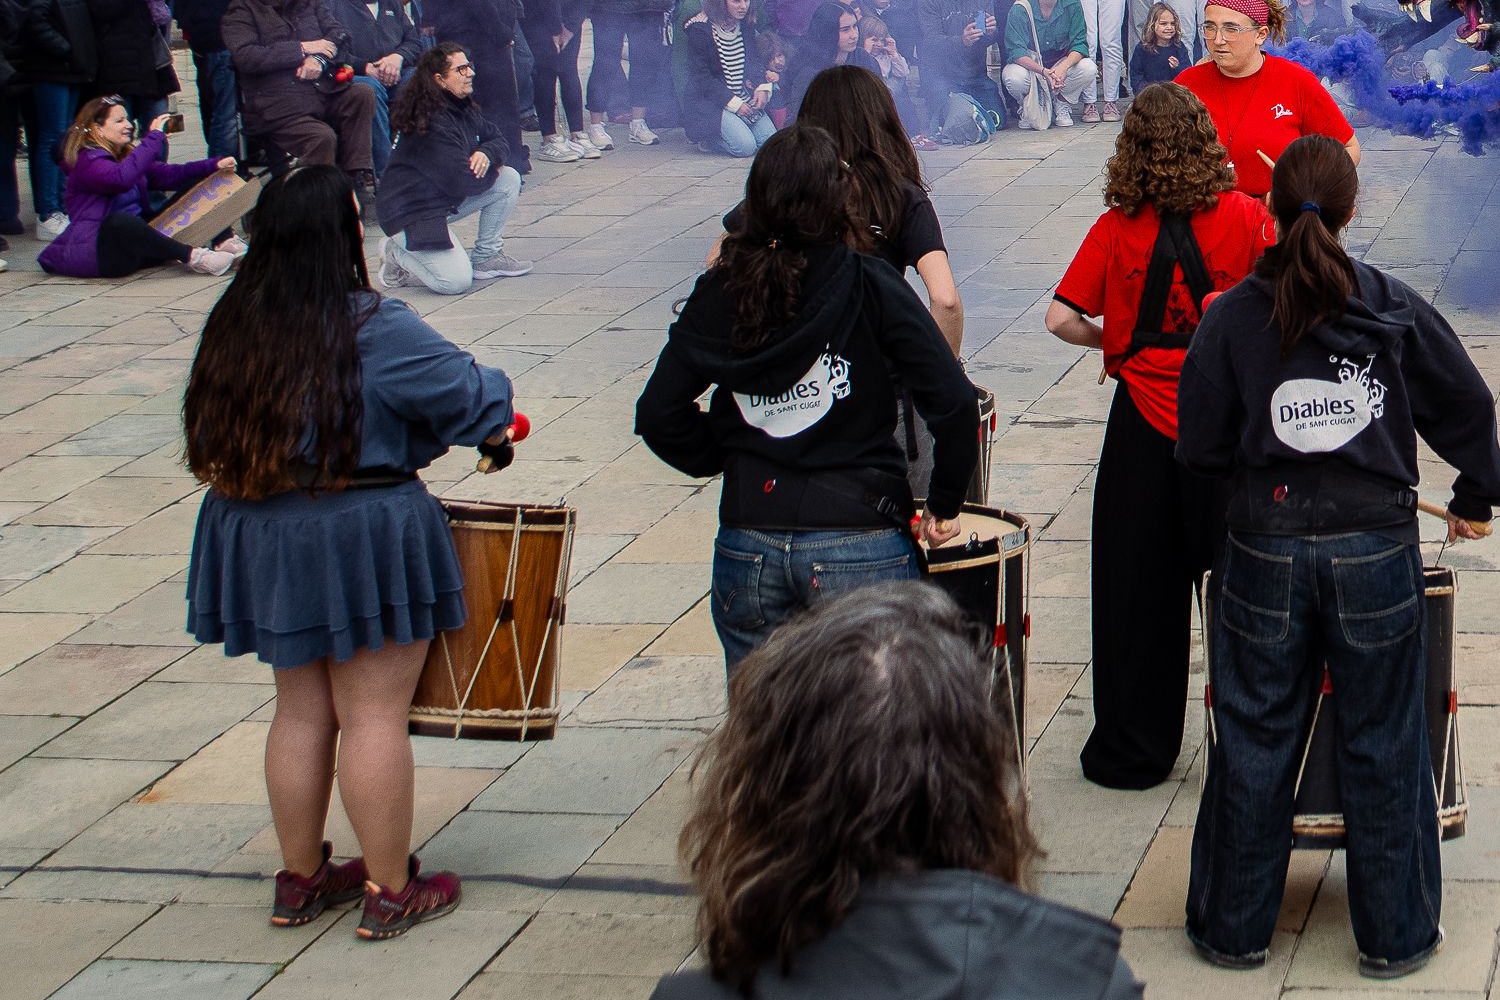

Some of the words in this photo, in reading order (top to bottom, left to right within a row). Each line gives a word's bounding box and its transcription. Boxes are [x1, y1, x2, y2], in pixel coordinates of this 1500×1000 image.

[764, 410, 776, 418] DE
[777, 403, 798, 414] SANT
[799, 400, 821, 411] CUGAT
[1279, 398, 1356, 423] Diables
[1295, 423, 1307, 431] DE
[1309, 420, 1328, 429] SANT
[1330, 417, 1357, 427] CUGAT
